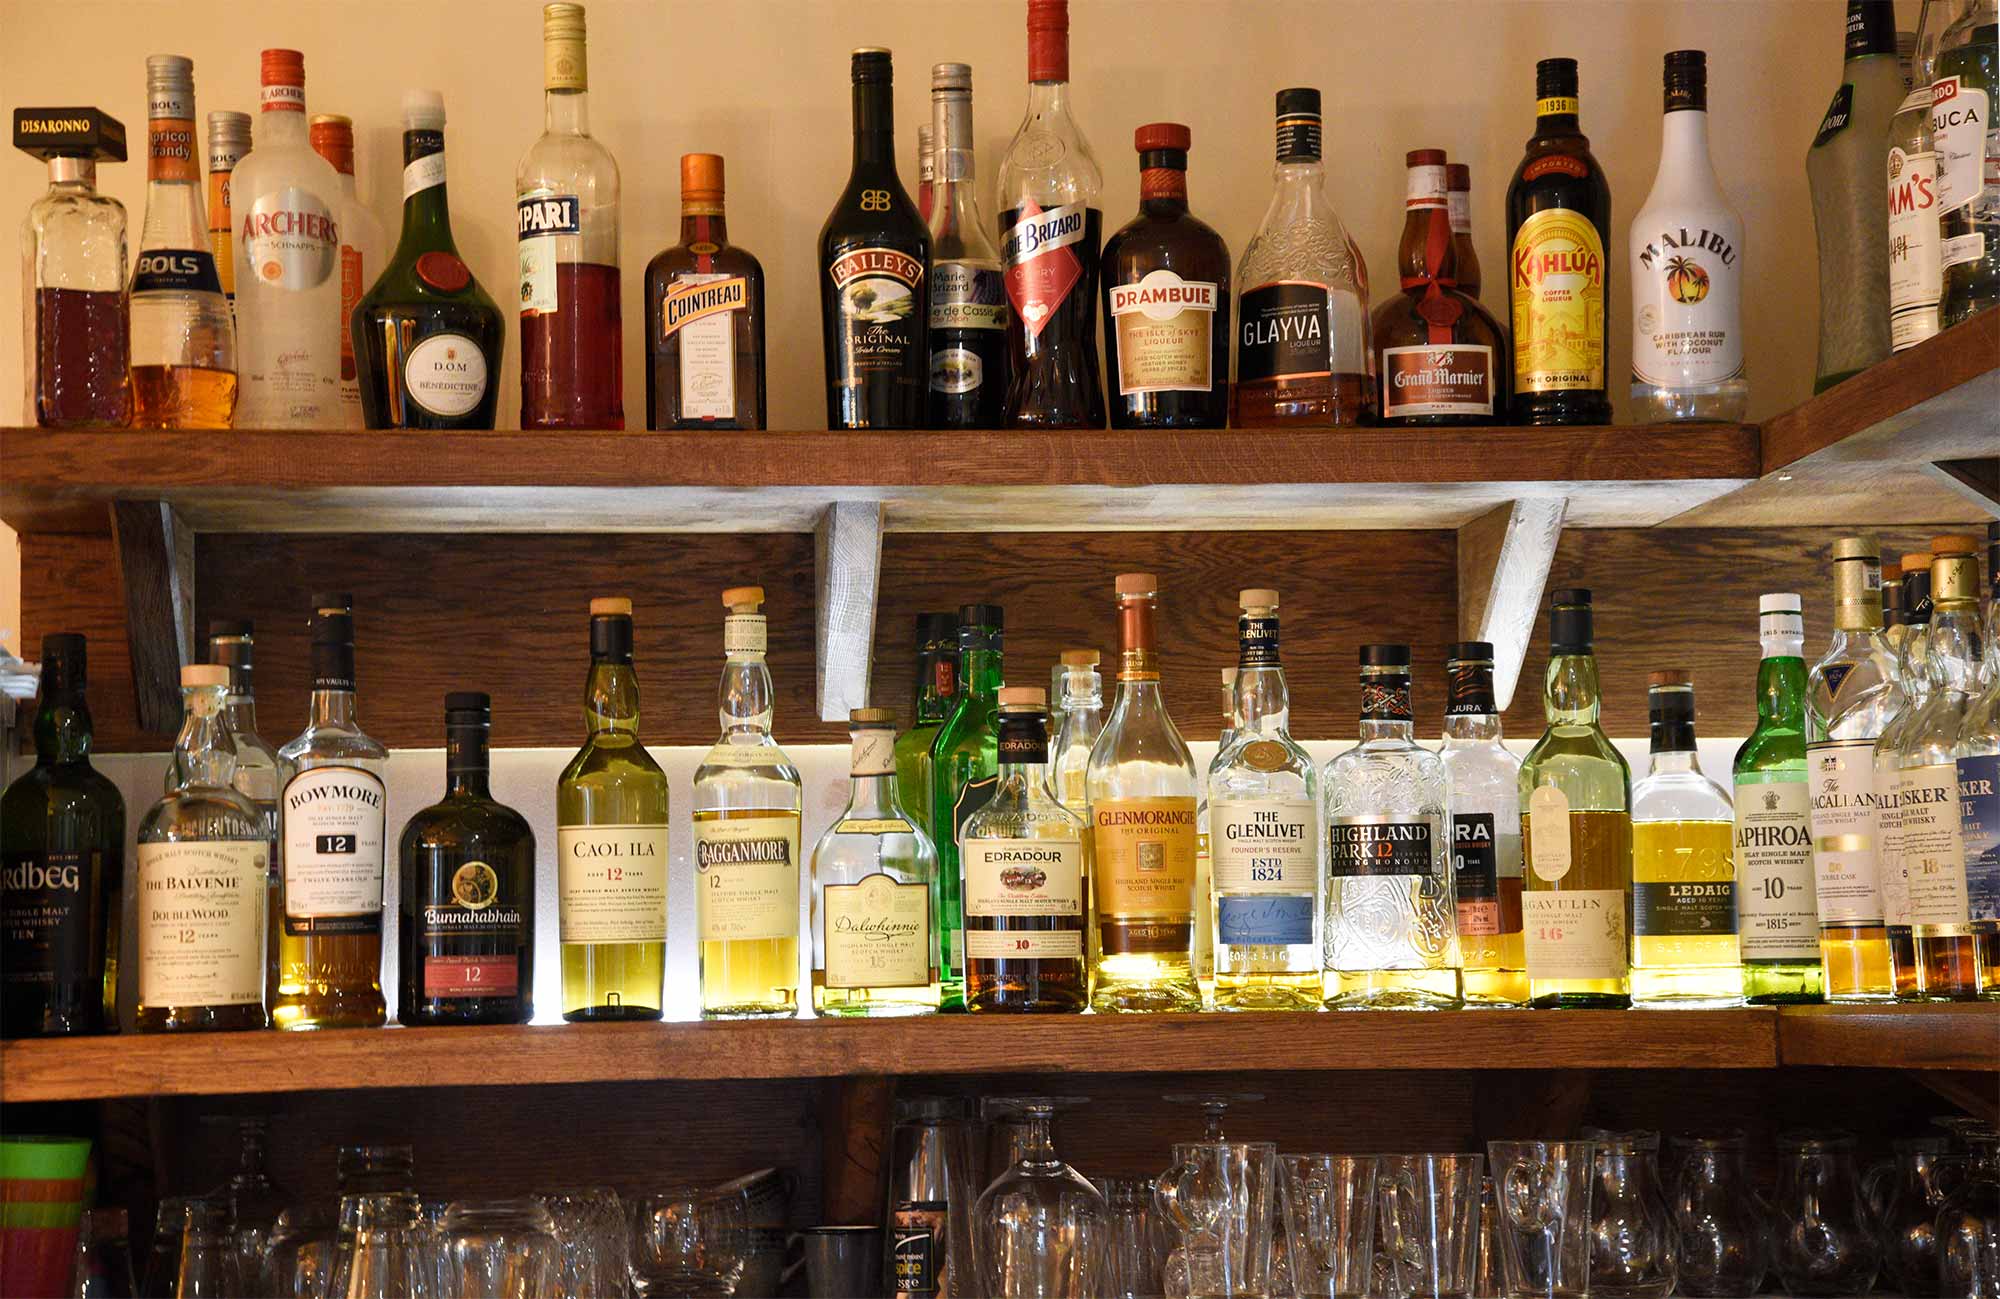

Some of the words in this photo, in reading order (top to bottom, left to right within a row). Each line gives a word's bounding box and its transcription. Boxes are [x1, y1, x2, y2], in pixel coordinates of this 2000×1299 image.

[1545, 99, 1567, 112] 1936
[20, 118, 91, 134] DISARONNO
[1530, 160, 1582, 175] IMPORTED
[241, 211, 339, 250] ARCHERS
[1026, 212, 1082, 254] BRIZARD
[270, 240, 316, 252] SCHNAPPS
[1639, 227, 1737, 271] MALIBU
[139, 255, 201, 275] BOLS
[834, 253, 920, 282] BAILEYS
[1514, 244, 1601, 289] KAHLÚA
[1115, 286, 1211, 309] DRAMBUIE
[1542, 295, 1573, 303] LIQUEUR
[1543, 289, 1571, 297] COFFEE
[668, 283, 741, 326] COINTREAU
[1146, 329, 1165, 337] ISLE
[1243, 313, 1321, 347] GLAYVA
[1652, 330, 1706, 342] CARIBBEAN
[1708, 330, 1726, 339] RUM
[844, 334, 911, 346] ORIGINAL
[1144, 337, 1185, 346] LIQUEUR
[1289, 339, 1322, 349] LIQUEUR
[1655, 338, 1678, 348] WITH
[1680, 338, 1725, 348] COCONUT
[1394, 368, 1433, 389] Grand
[1433, 366, 1485, 387] Marnier
[1544, 374, 1592, 384] ORIGINAL
[1249, 622, 1264, 630] THE
[1452, 703, 1482, 713] JURA
[1822, 778, 1839, 794] The
[289, 785, 383, 811] BOWMORE
[1098, 809, 1195, 827] GLENMORANGIE
[1253, 811, 1279, 823] THE
[1136, 827, 1180, 836] ORIGINAL
[1226, 823, 1305, 840] GLENLIVET
[1331, 825, 1428, 842] HIGHLAND
[326, 836, 347, 853] 12
[573, 840, 624, 859] CAOL
[630, 841, 656, 857] ILA
[1231, 847, 1271, 855] FOUNDER'S
[1332, 843, 1374, 860] PARK
[1376, 842, 1394, 857] 12
[184, 849, 212, 858] SCOTCH
[984, 851, 1063, 863] EDRADOUR
[1761, 850, 1788, 858] SINGLE
[1789, 850, 1811, 858] MALT
[1375, 858, 1429, 866] HONOUR
[1747, 859, 1773, 867] SCOTCH
[1773, 858, 1805, 866] WHISKY
[1921, 857, 1940, 875] 18
[607, 867, 623, 881] 12
[1251, 868, 1283, 882] 1824
[145, 880, 162, 891] THE
[166, 877, 240, 890] BALVENIE
[710, 874, 721, 889] 12
[1763, 876, 1785, 900] 10
[1669, 884, 1731, 897] LEDAIG
[42, 906, 71, 916] MALT
[152, 908, 229, 922] DOUBLEWOOD
[424, 908, 521, 925] Bunnahabhain
[22, 917, 62, 928] WHISKY
[834, 914, 921, 934] Dalwhinnie
[1766, 918, 1788, 930] 1815
[12, 929, 35, 940] TEN
[179, 929, 196, 944] 12
[1538, 927, 1564, 942] 16
[1015, 939, 1030, 950] 10
[464, 966, 481, 983] 12
